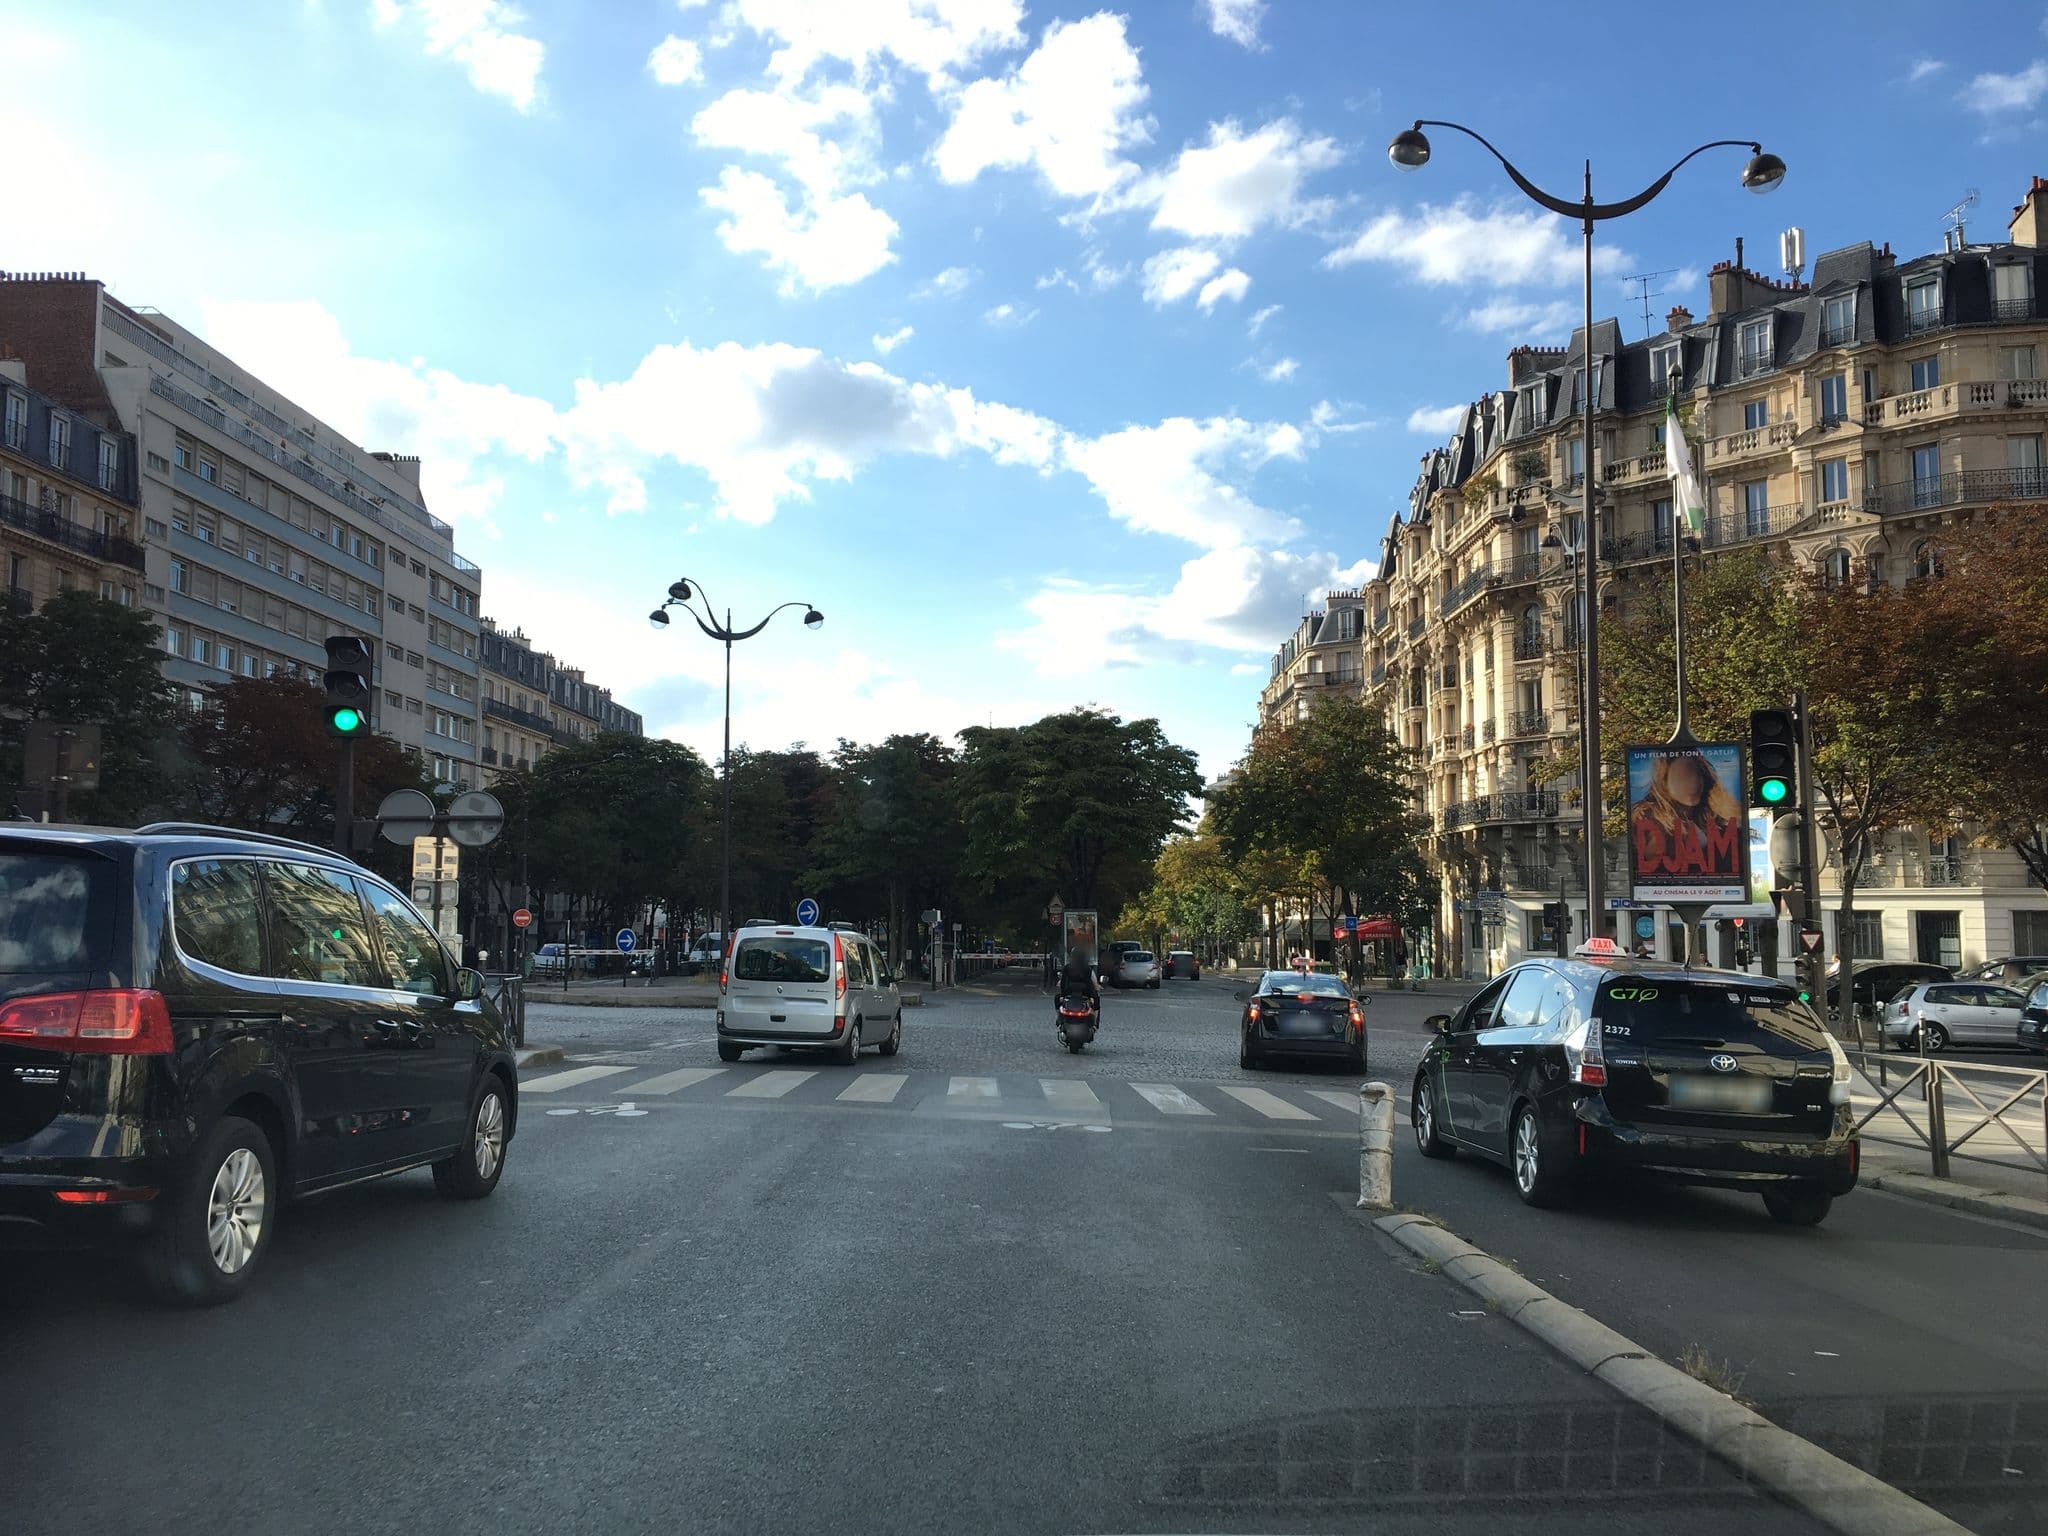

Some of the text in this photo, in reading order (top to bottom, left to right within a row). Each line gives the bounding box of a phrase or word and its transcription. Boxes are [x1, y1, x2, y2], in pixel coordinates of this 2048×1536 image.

[1635, 817, 1740, 874] DJAM
[1591, 939, 1612, 948] TAXI
[1609, 988, 1639, 1000] G7
[1604, 1024, 1631, 1036] 2372
